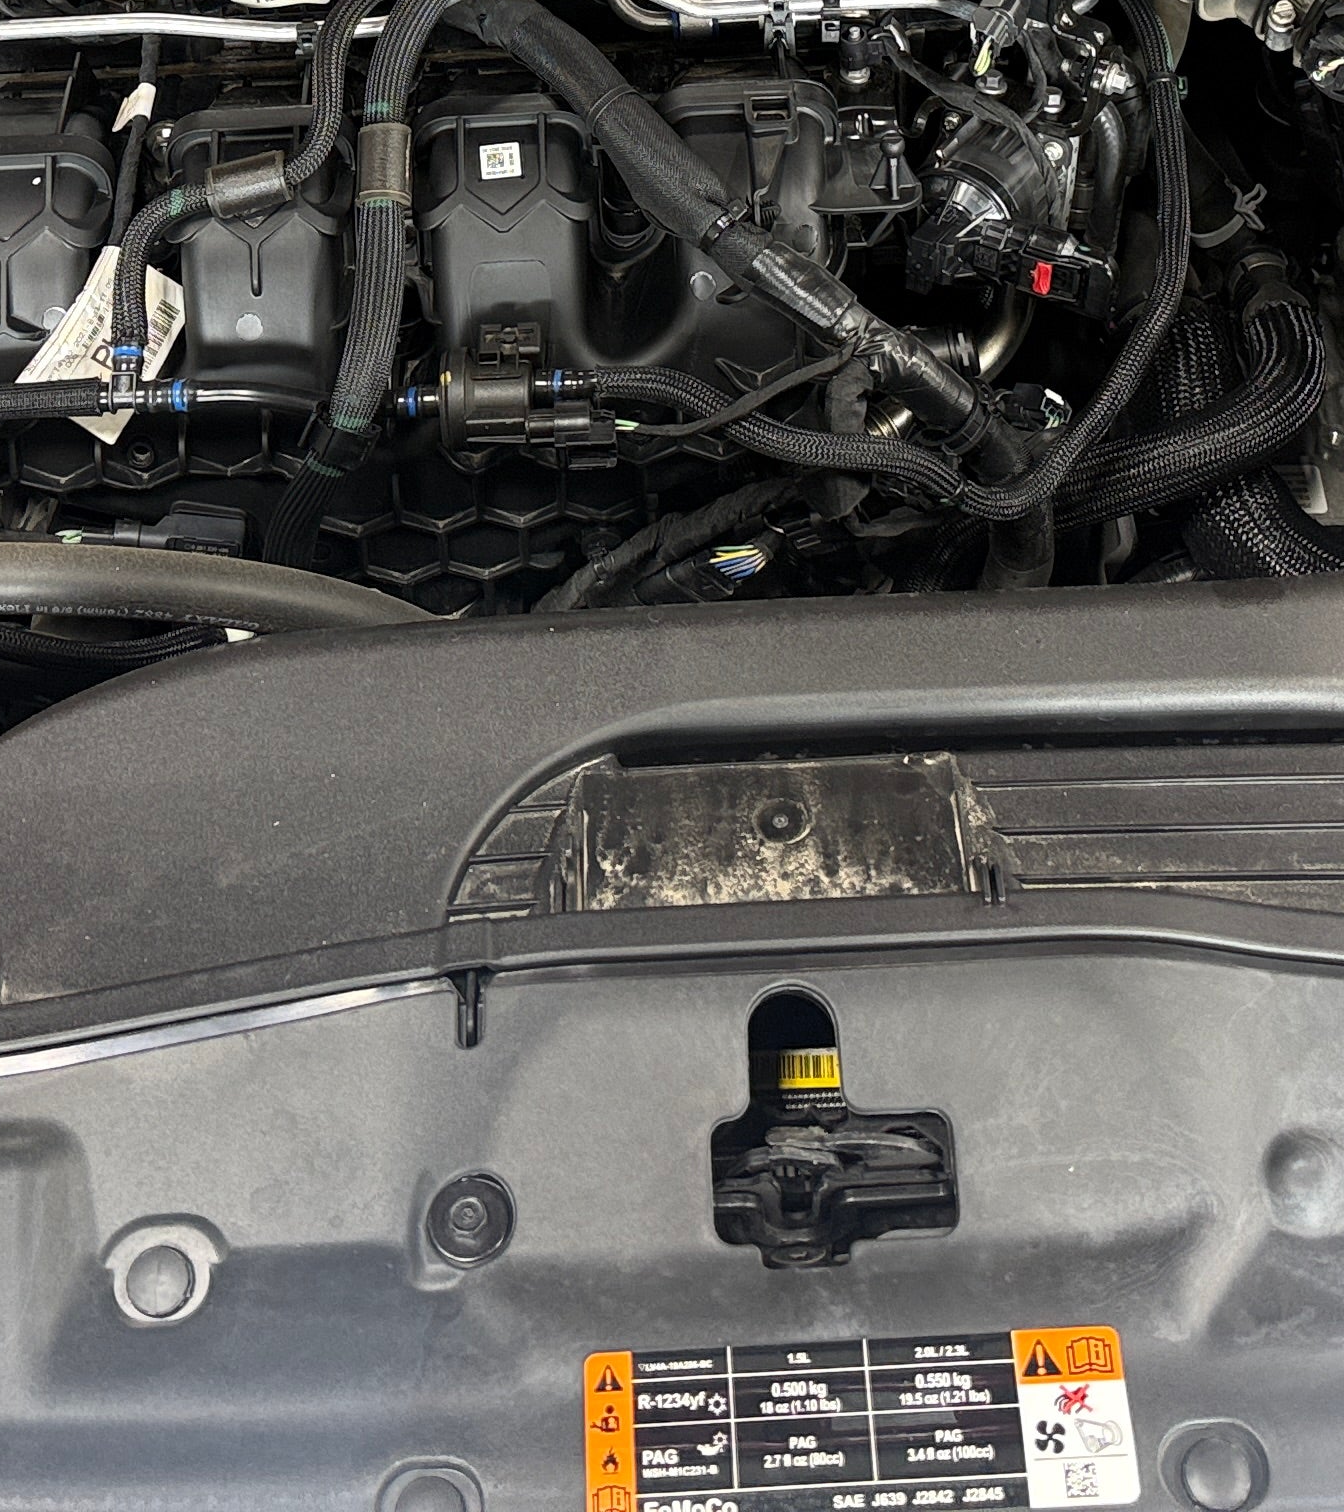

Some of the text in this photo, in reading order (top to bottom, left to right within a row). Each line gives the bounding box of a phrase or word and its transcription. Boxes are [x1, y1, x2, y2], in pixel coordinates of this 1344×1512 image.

[771, 1380, 828, 1399] 0.500 kg
[914, 1372, 972, 1390] 0.550 kg
[637, 1391, 706, 1411] R-1234yf
[760, 1397, 841, 1415] 18 oz (1.10 lbs)
[898, 1389, 991, 1406] 19.5 oz (1.21 lbs)
[788, 1435, 818, 1450] PAG
[934, 1428, 964, 1443] PAG
[641, 1448, 680, 1466] PAG
[763, 1455, 781, 1469] 2.7
[793, 1455, 807, 1467] oz
[907, 1448, 925, 1462] 3.4
[937, 1449, 951, 1460] oz
[953, 1444, 994, 1462] (100cc)
[832, 1487, 1005, 1509] SAE J639 J2842 J2845
